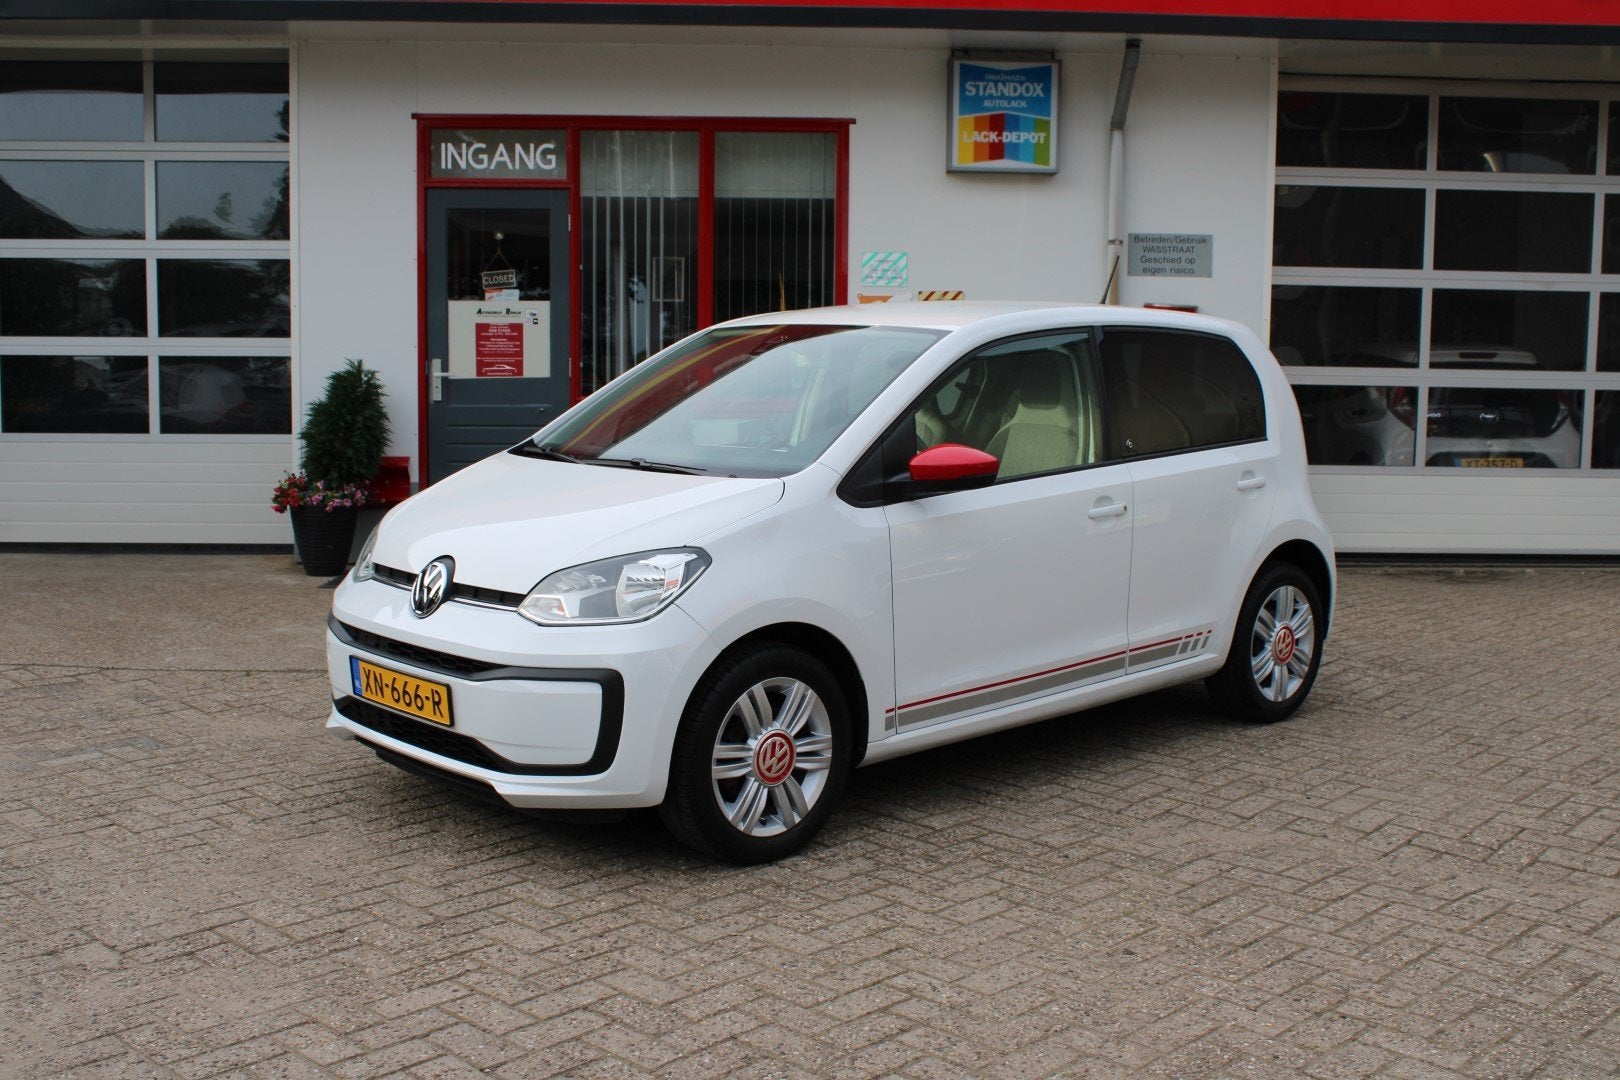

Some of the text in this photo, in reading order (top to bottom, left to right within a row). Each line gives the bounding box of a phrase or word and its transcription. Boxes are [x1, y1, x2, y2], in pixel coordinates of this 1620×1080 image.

[965, 81, 1045, 98] STANDOX
[983, 100, 1028, 109] AUTOLACK
[962, 131, 1047, 144] LACK-DEPOT
[440, 142, 556, 170] INGANG
[1134, 235, 1208, 244] Betreden/Gebruik
[1142, 246, 1195, 254] WASSTRAAT
[1140, 255, 1196, 265] Geschied op
[1142, 267, 1167, 275] eigen
[483, 274, 515, 285] CLOSED
[362, 666, 444, 718] XN-666-R
